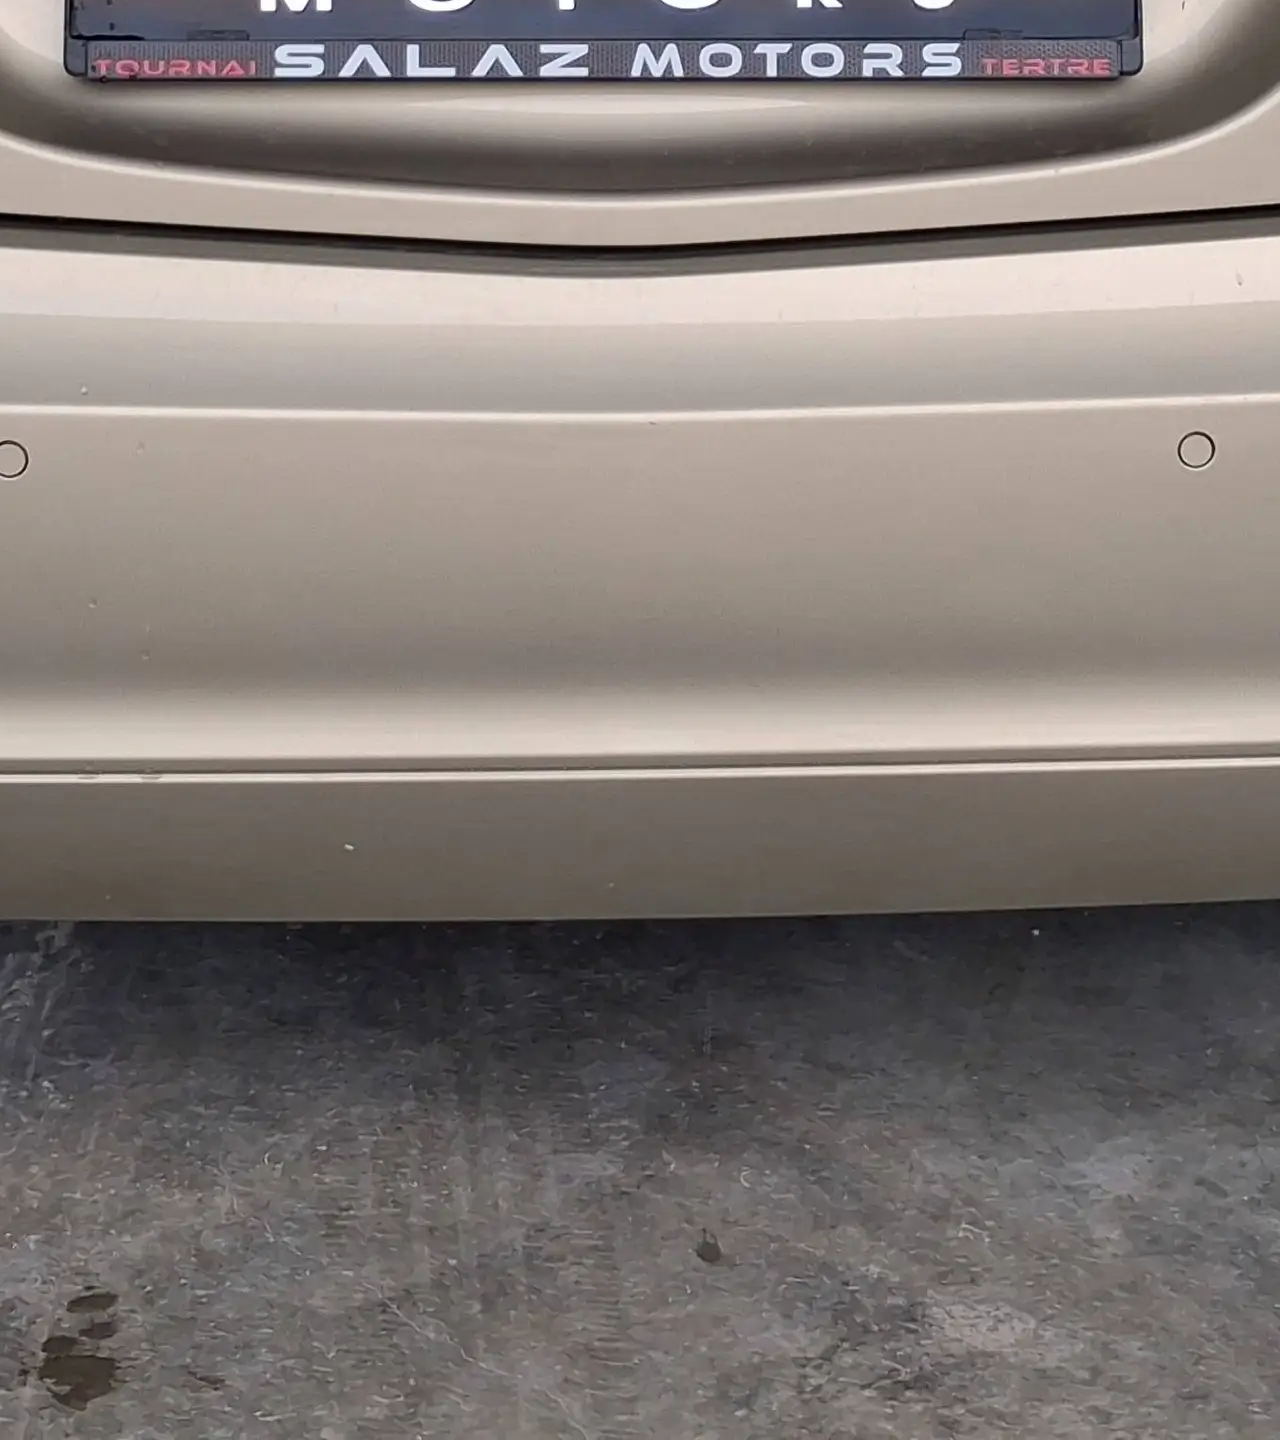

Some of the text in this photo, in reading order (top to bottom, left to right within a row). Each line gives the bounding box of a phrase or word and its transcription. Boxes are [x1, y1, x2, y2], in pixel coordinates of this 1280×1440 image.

[94, 42, 1111, 78] TOURNAI SALAZ MOTORS TERTRE
